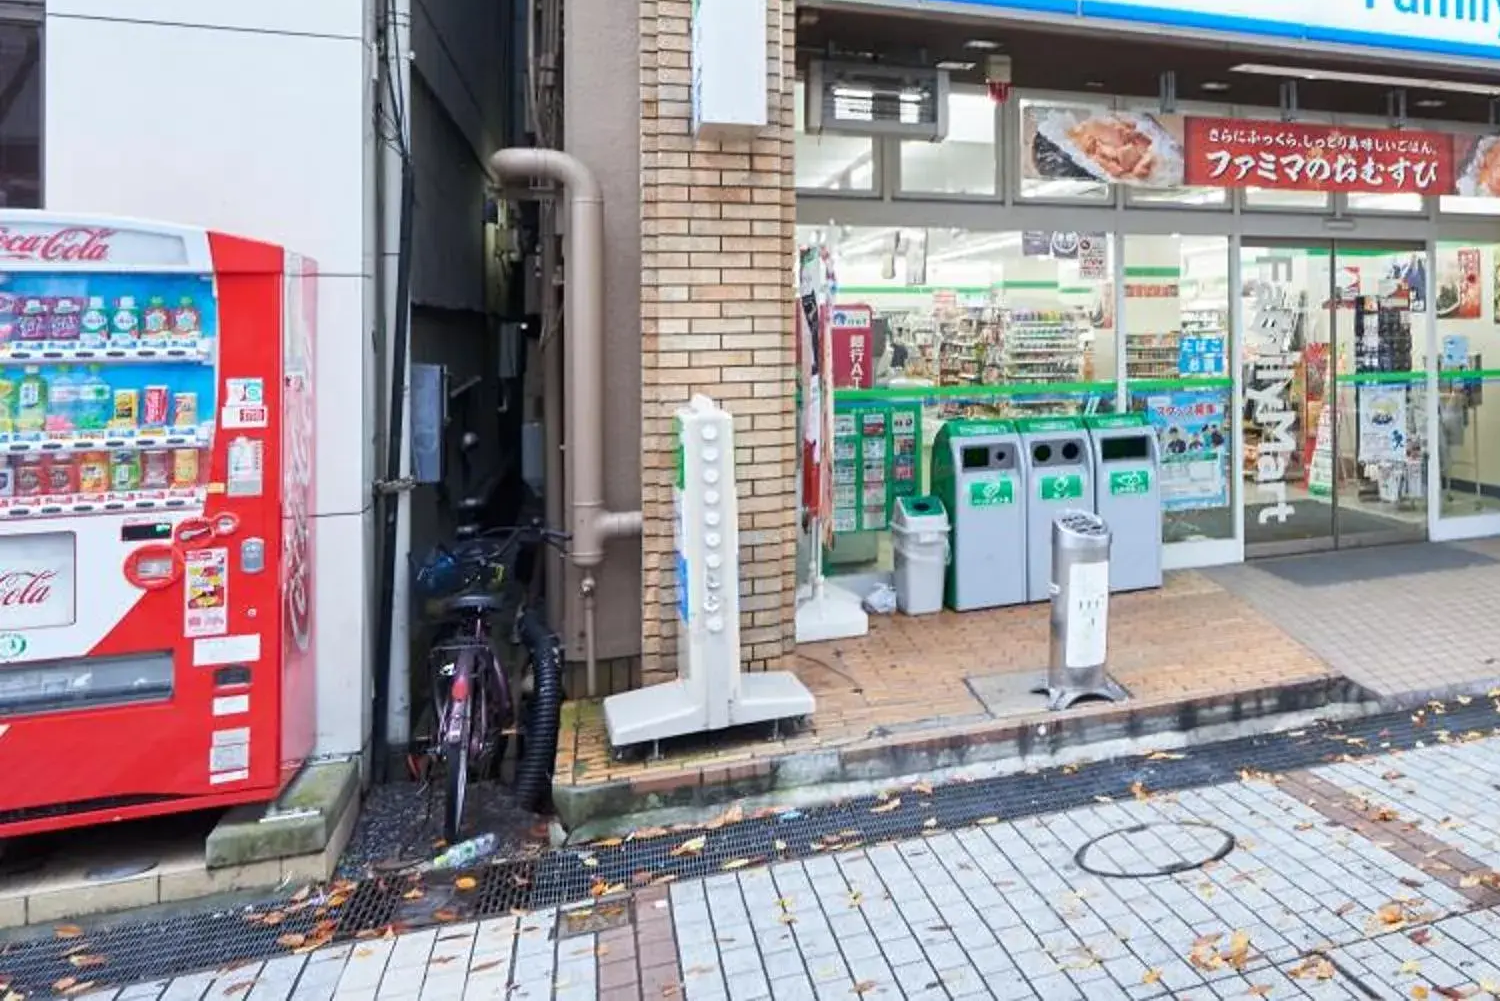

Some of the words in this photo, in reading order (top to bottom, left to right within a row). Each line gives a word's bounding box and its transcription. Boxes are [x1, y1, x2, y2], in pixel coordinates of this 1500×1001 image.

[1206, 149, 1438, 188] ファミマのおむすび
[849, 335, 865, 389] 銀行AT
